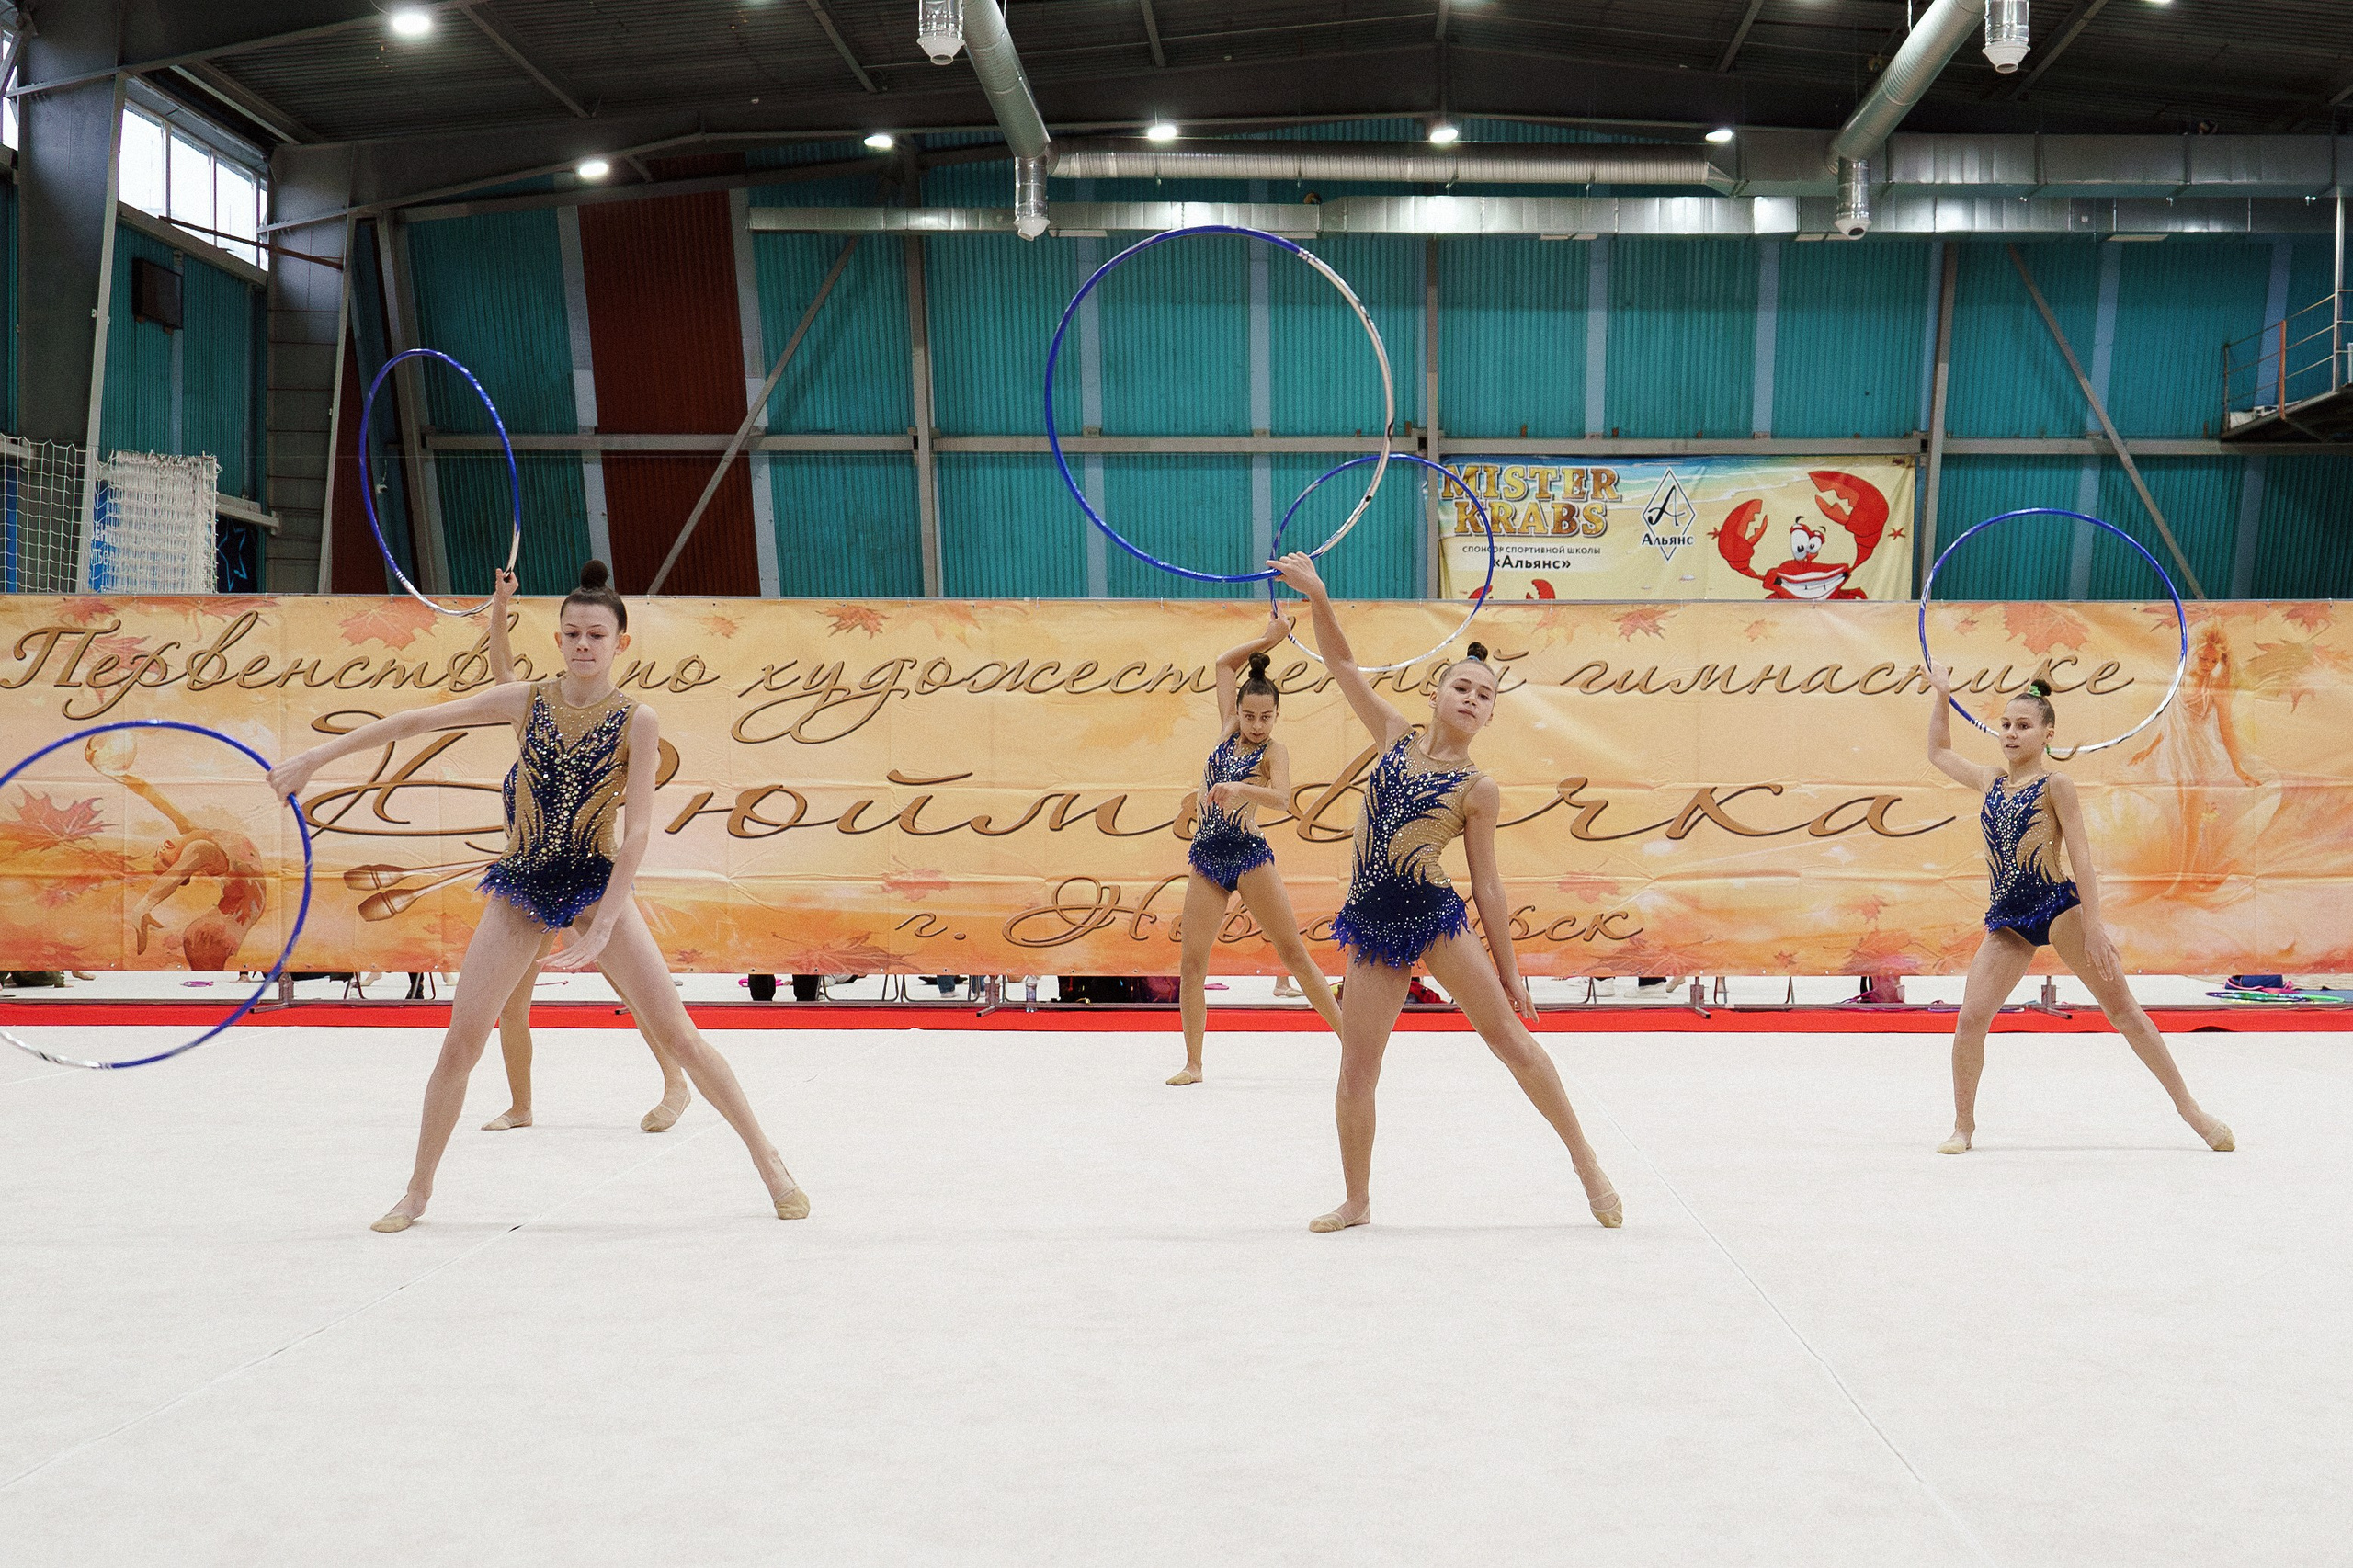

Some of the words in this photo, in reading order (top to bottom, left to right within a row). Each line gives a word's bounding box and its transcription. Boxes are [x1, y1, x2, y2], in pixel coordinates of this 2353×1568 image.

[1441, 465, 1622, 502] MISTER
[1454, 501, 1609, 538] KRABS
[1506, 544, 1565, 554] СПОРТИВНОЙ
[1567, 546, 1601, 555] ШКОЛЫ
[1641, 533, 1694, 546] Альянс
[894, 912, 966, 941] г.
